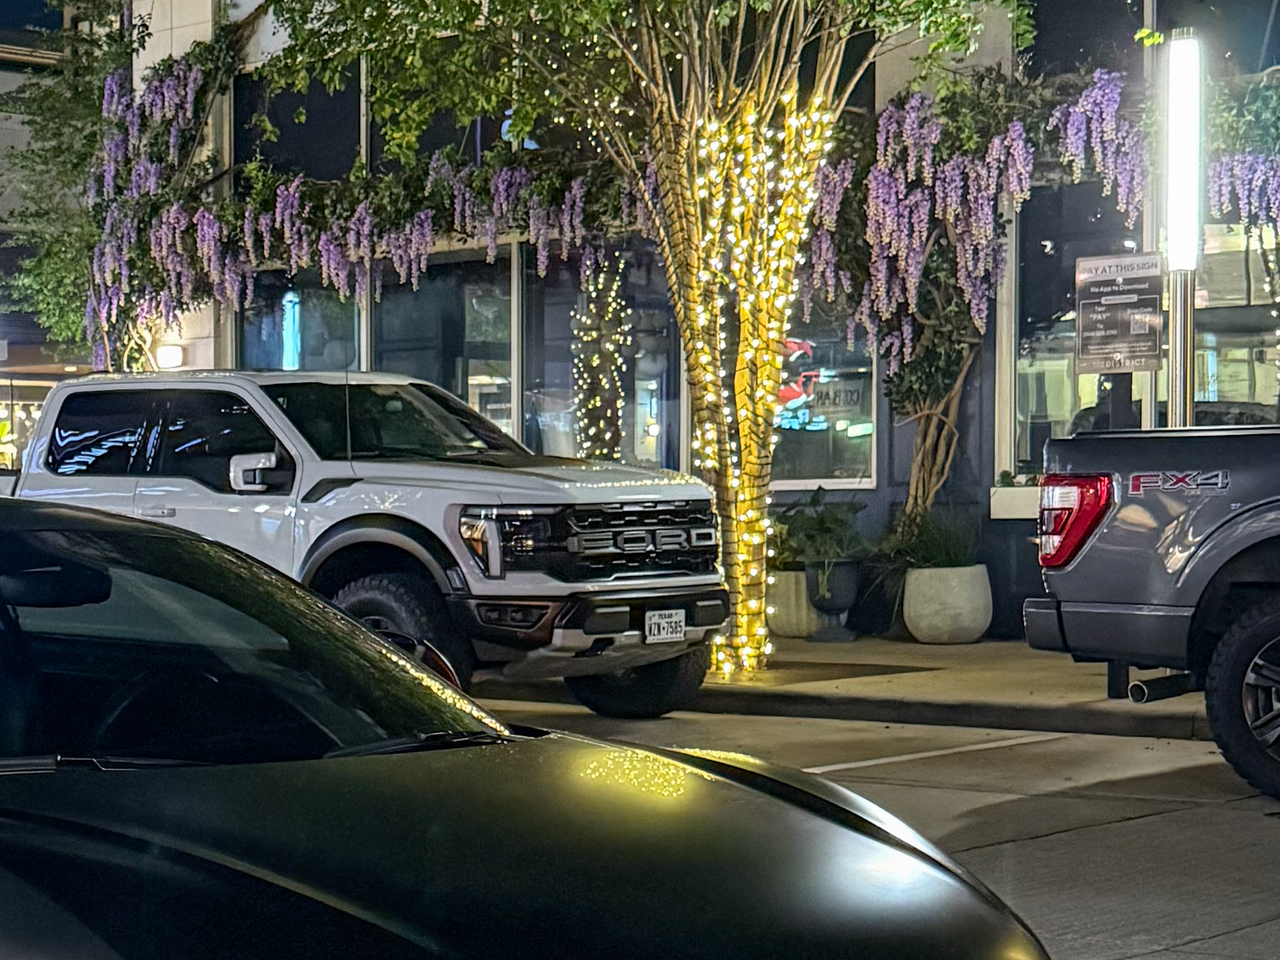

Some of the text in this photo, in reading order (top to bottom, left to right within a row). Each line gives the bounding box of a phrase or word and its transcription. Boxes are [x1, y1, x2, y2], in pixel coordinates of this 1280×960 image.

[1083, 261, 1158, 276] AY AT THIS SIGN
[1099, 285, 1112, 294] App
[1105, 358, 1146, 368] DISTRICT
[1127, 470, 1230, 497] FX4
[567, 528, 716, 553] FORD
